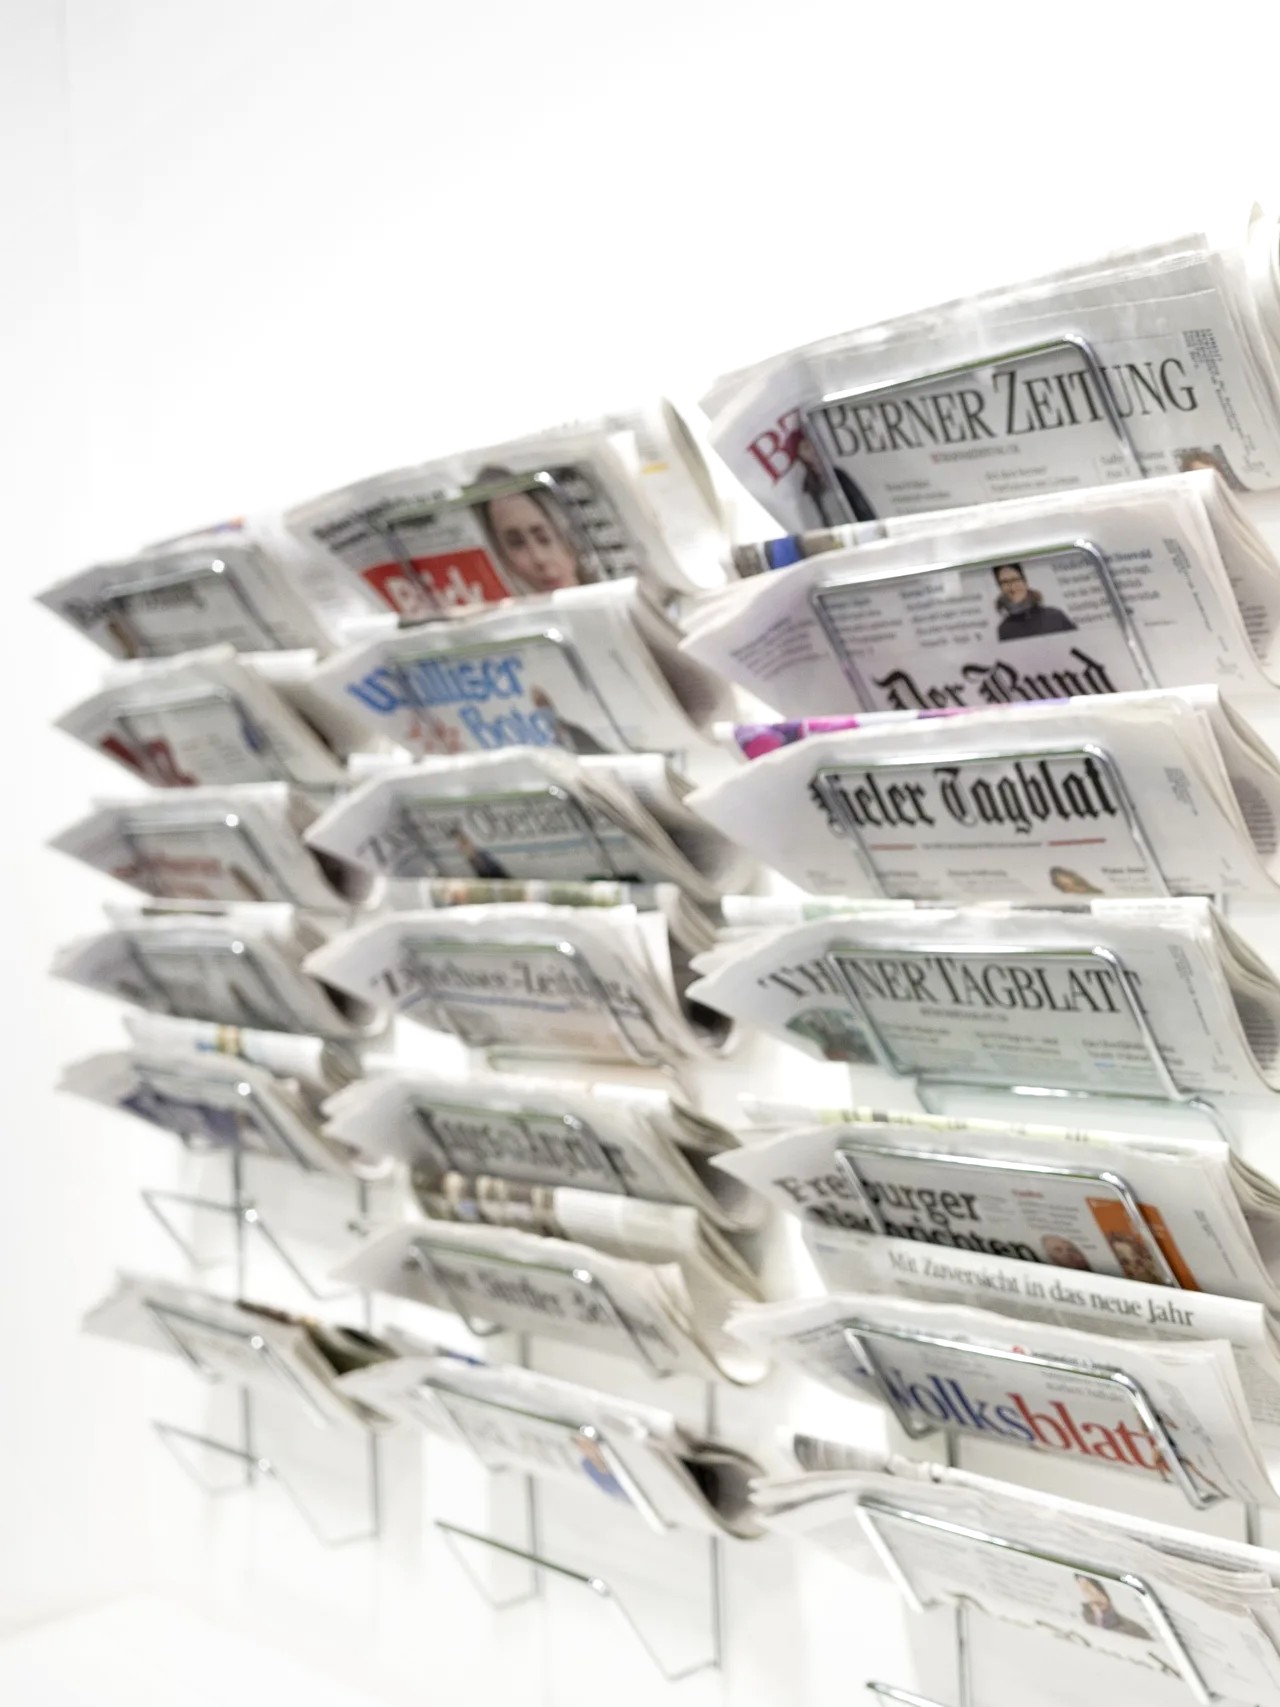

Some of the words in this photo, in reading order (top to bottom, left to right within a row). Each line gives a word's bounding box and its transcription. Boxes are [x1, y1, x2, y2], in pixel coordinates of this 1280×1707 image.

[816, 390, 990, 460] BERNER
[991, 356, 1201, 451] ZEITUNG
[922, 1256, 1021, 1295] Zuversicht
[1024, 1276, 1046, 1300] in
[1050, 1281, 1087, 1306] das
[1088, 1292, 1143, 1318] neue
[1147, 1297, 1195, 1328] Jahr
